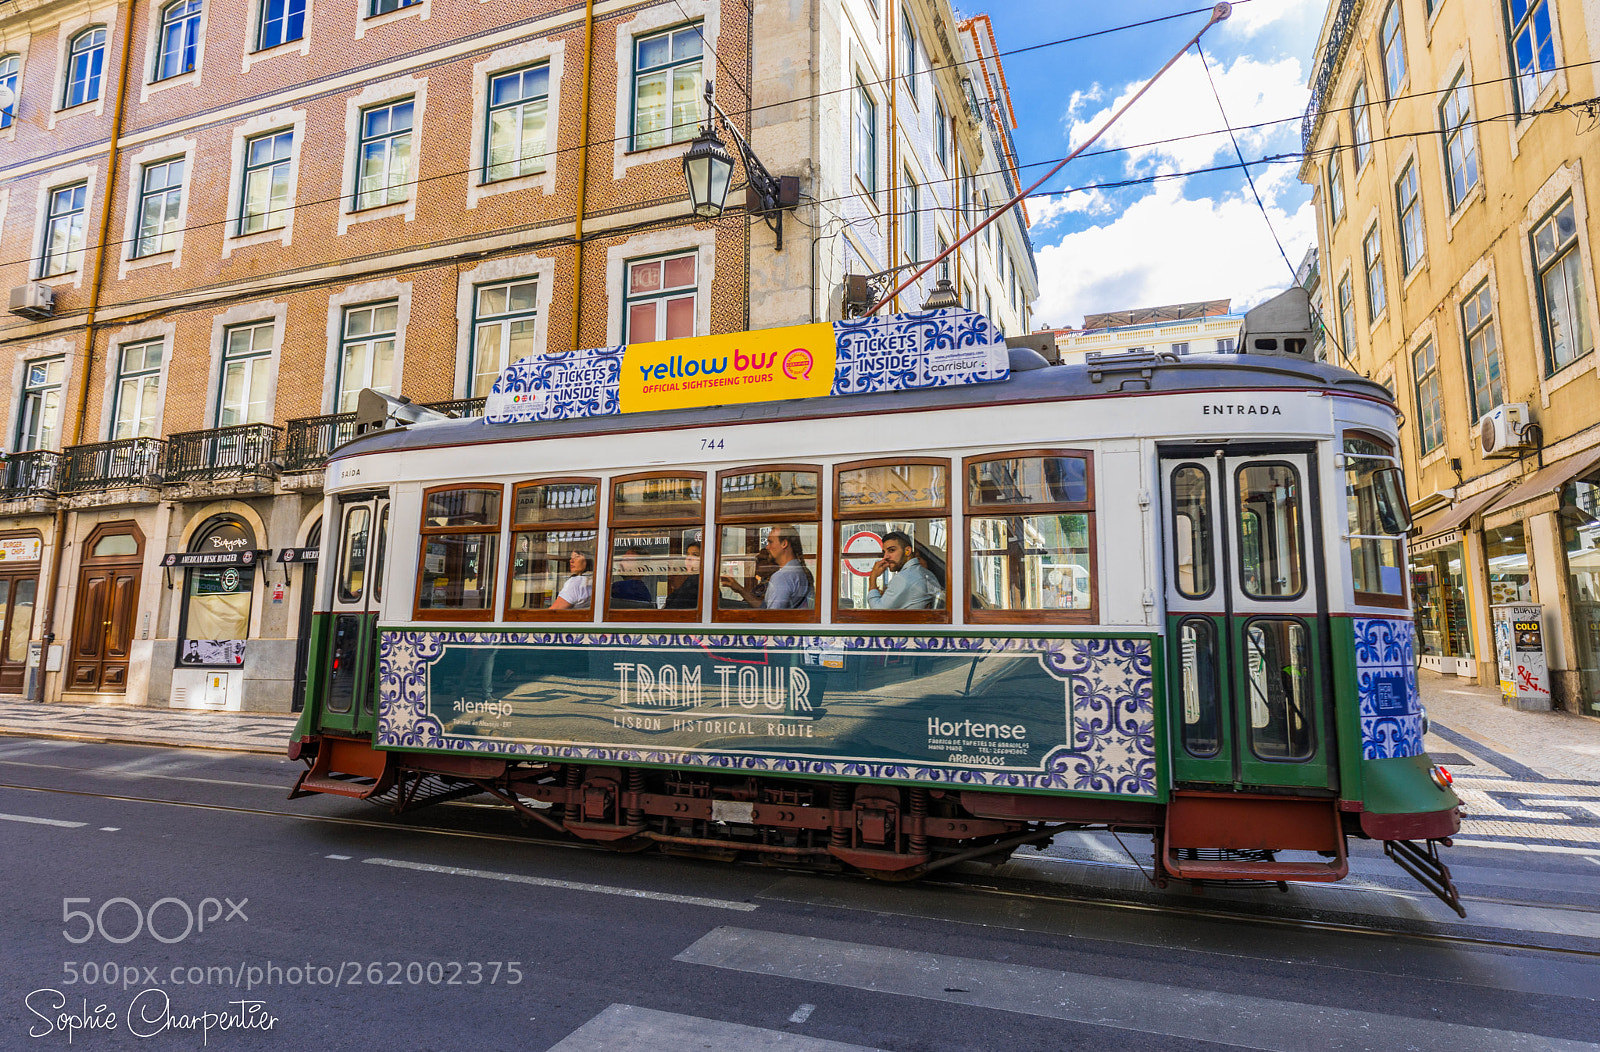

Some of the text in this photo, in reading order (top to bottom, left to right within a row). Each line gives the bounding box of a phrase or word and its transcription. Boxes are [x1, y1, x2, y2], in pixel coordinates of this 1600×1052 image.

[855, 334, 916, 352] TICKETS
[640, 349, 778, 381] yellow bus
[859, 354, 910, 372] INSIDE
[931, 359, 978, 372] carristur
[558, 367, 606, 384] TICKETS
[642, 373, 773, 394] OFFICIAL SIGHTSEEING TOURS
[560, 385, 600, 400] INSIDE
[1203, 405, 1282, 415] ENTRADA
[700, 438, 725, 450] 744
[633, 537, 654, 546] MUSIC
[181, 556, 203, 564] AMERICAN
[1515, 623, 1538, 631] COLO
[613, 662, 813, 712] TRAM TOUR
[453, 697, 513, 719] alentejo
[614, 716, 813, 738] LISBON HISTORICAL ROUTE
[928, 717, 1026, 739] Hortense
[948, 753, 1005, 766] ARRAIOLOS
